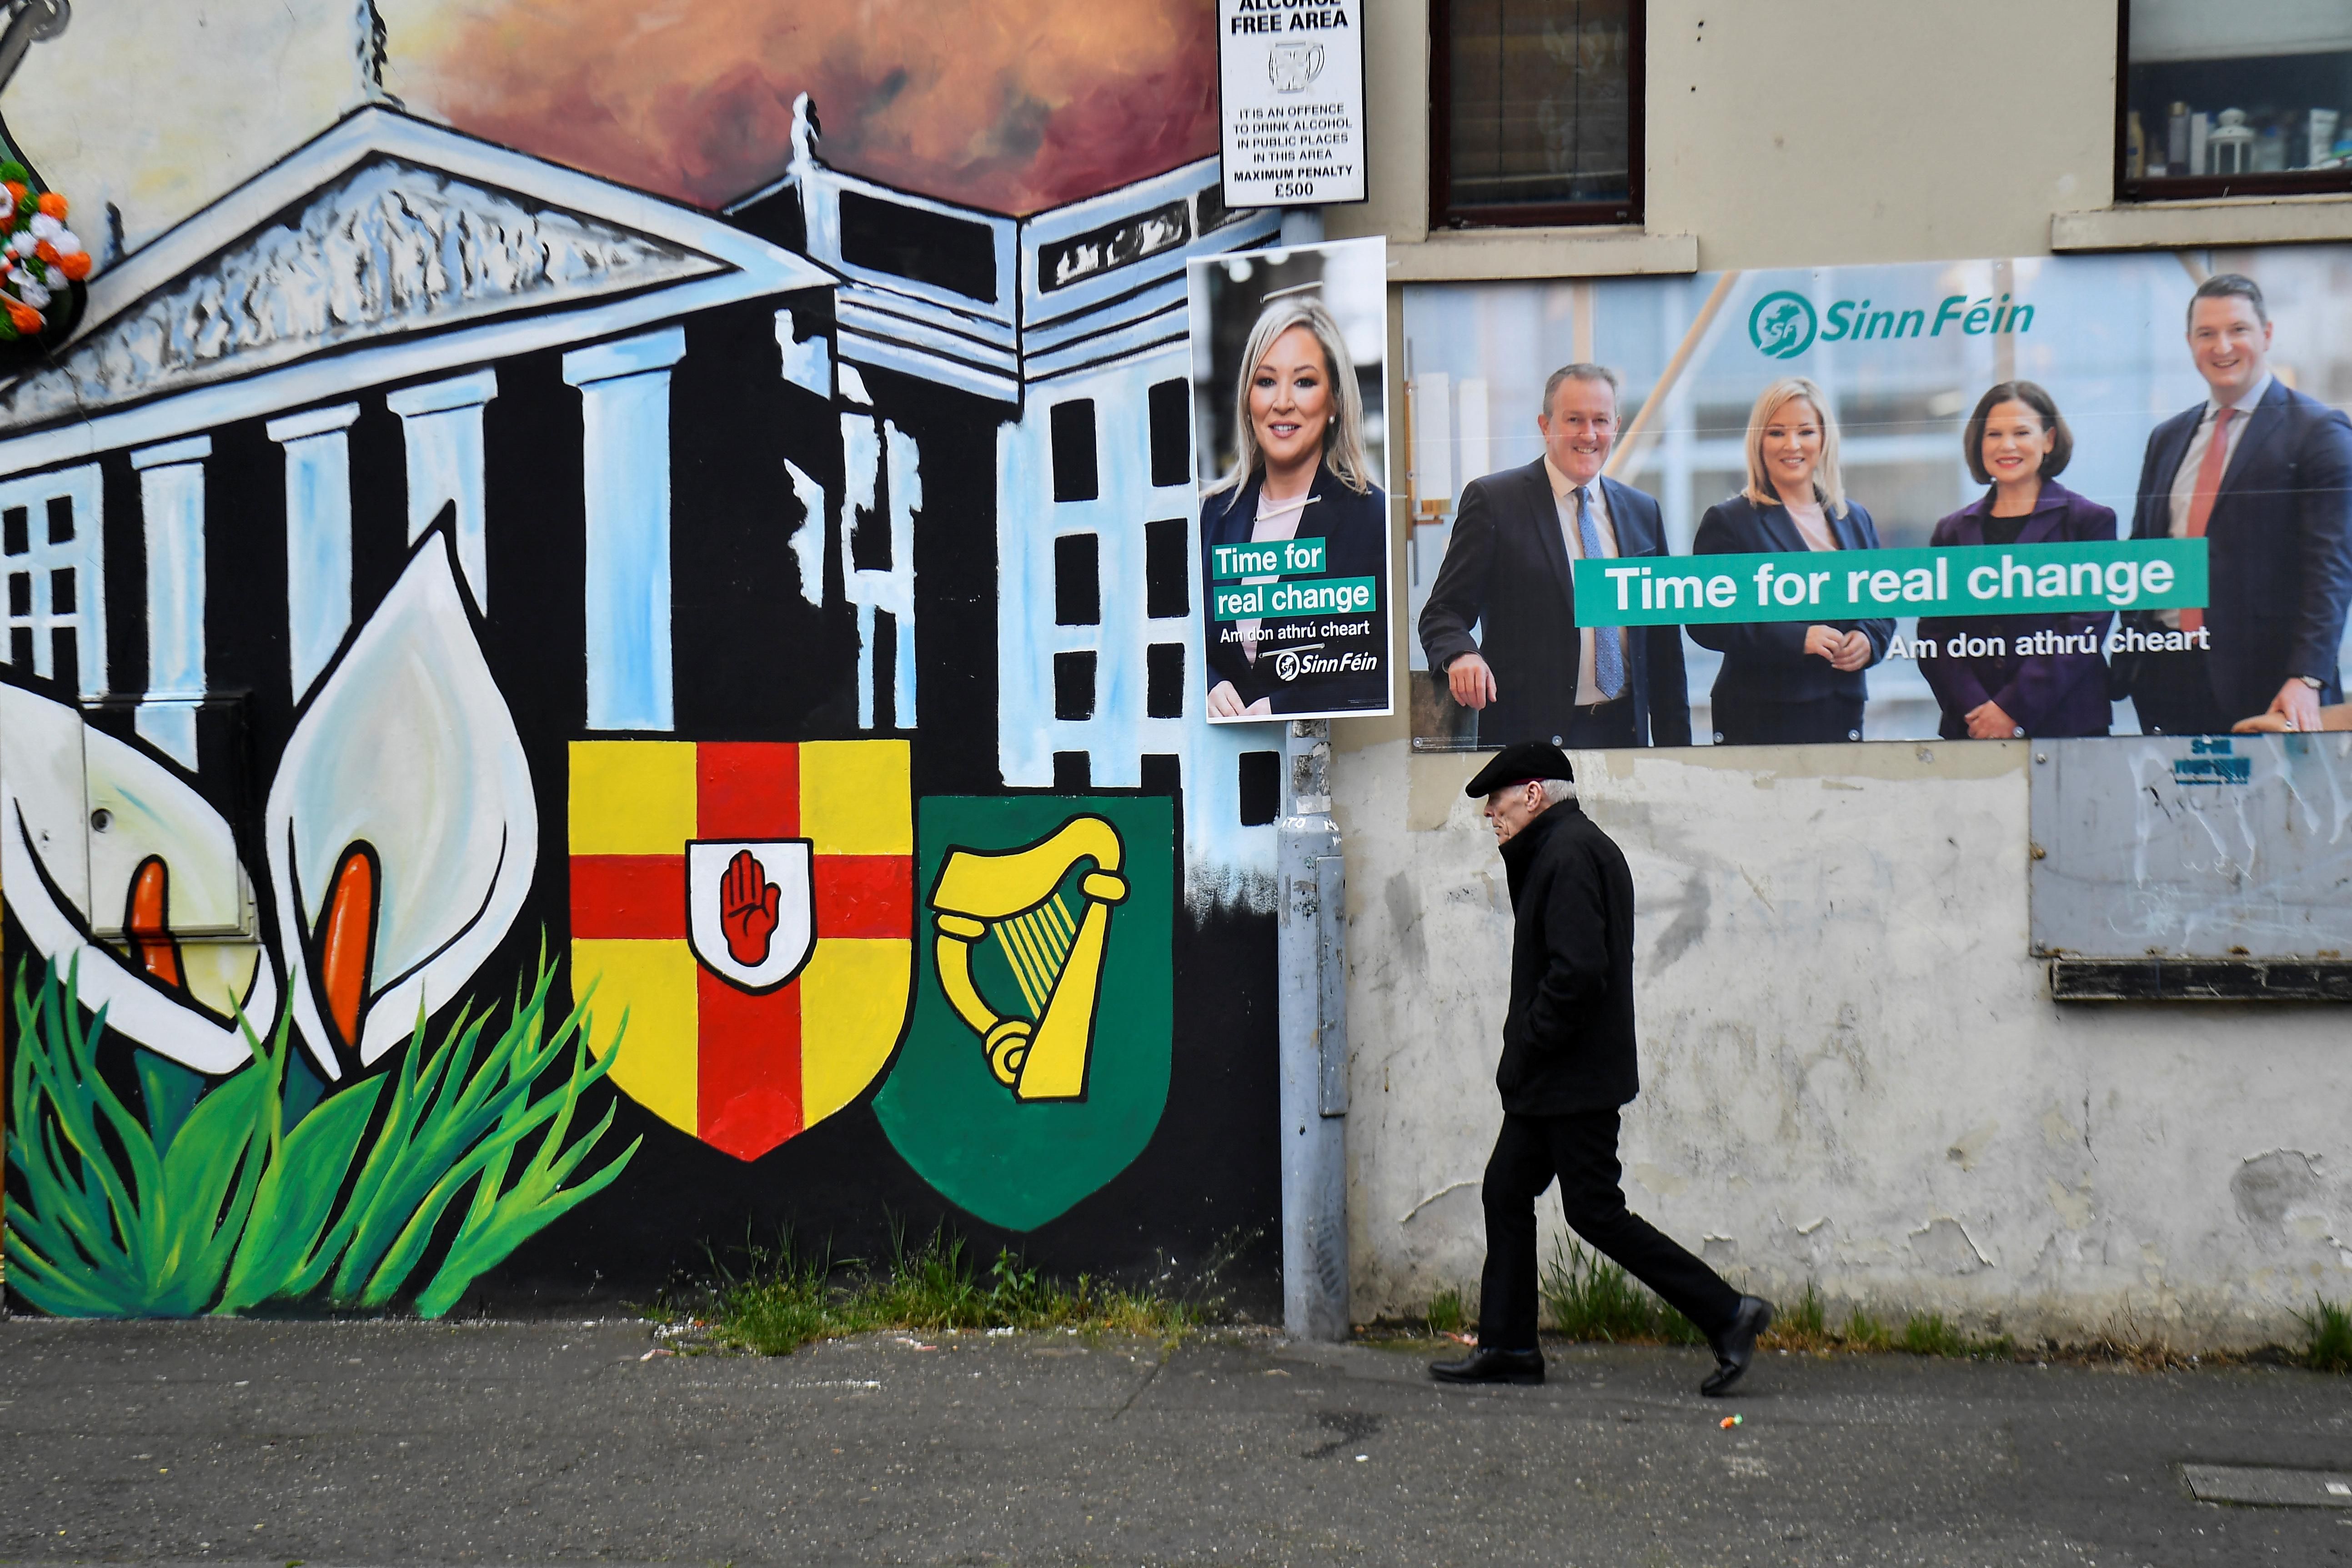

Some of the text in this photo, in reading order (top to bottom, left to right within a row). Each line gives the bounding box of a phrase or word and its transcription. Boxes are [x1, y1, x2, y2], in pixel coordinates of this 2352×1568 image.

[1231, 8, 1349, 36] FREE AREA
[1240, 103, 1344, 120] IT IS AN OFFENCE
[1233, 116, 1353, 135] TO DRINK ALCOHOL
[1237, 132, 1348, 150] IN PUBLIC PLACES
[1254, 148, 1333, 164] IN THIS AREA
[1234, 164, 1353, 182] MAXIMUM PENALTY
[1275, 181, 1314, 198] £500
[1820, 292, 2035, 341] Sinn Féin
[1215, 543, 1322, 574] Time for
[1605, 554, 2176, 610] Time for real change
[1218, 584, 1369, 615] real change
[1219, 619, 1370, 644] Am don athrú cheart
[1885, 625, 2212, 661] Am don athrú cheart
[1300, 651, 1378, 674] Sinn Féin
